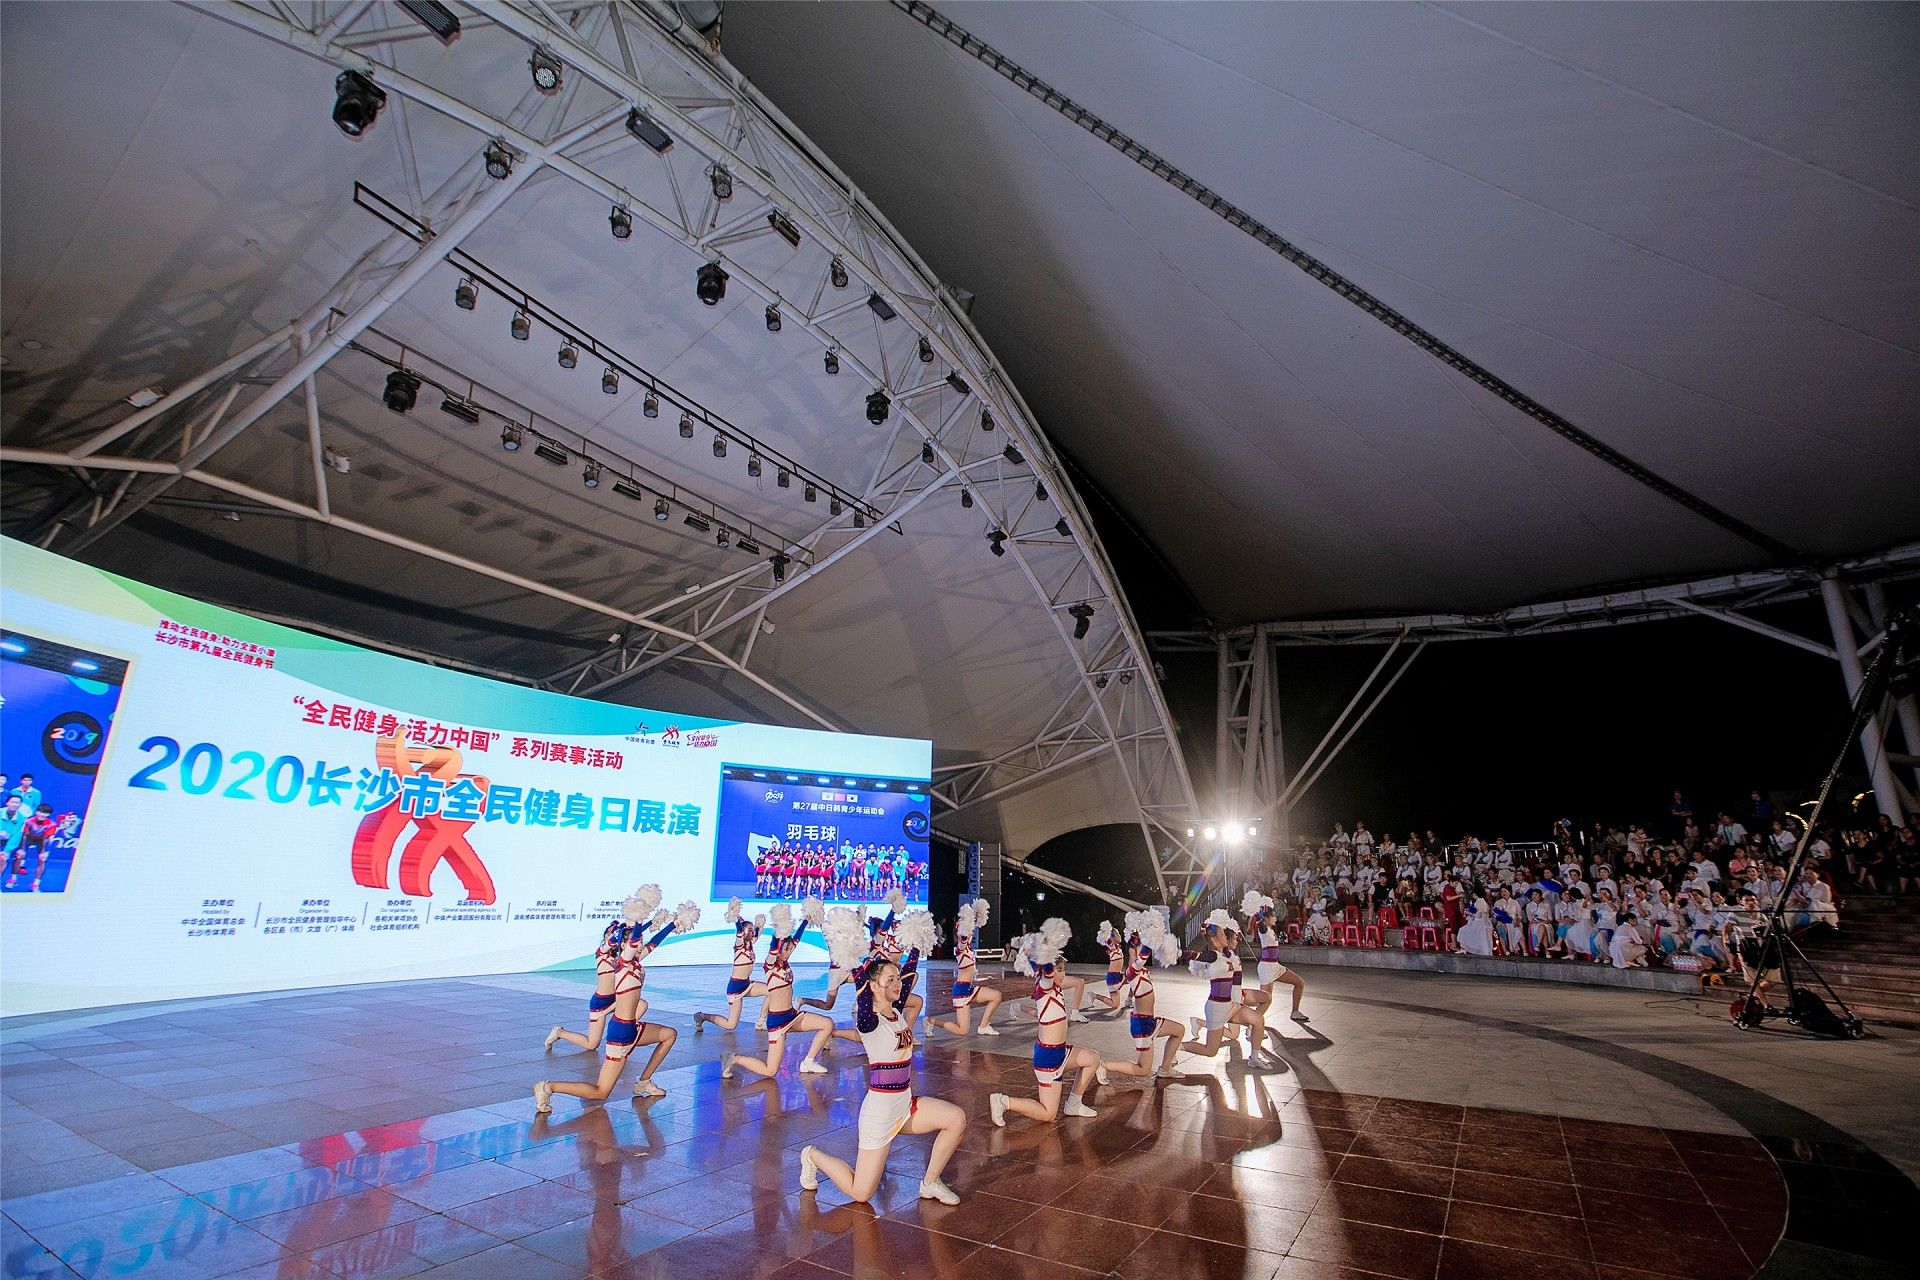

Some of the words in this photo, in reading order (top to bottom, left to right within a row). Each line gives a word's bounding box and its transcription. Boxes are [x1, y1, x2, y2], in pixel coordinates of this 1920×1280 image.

[155, 631, 275, 669] 长沙市第九届全民健身节
[510, 736, 623, 771] 系列赛事活动
[128, 735, 702, 838] 2020长沙市全民健身日展演
[792, 801, 885, 816] 第27届中日韩青少年运动会
[787, 823, 837, 841] 羽毛球
